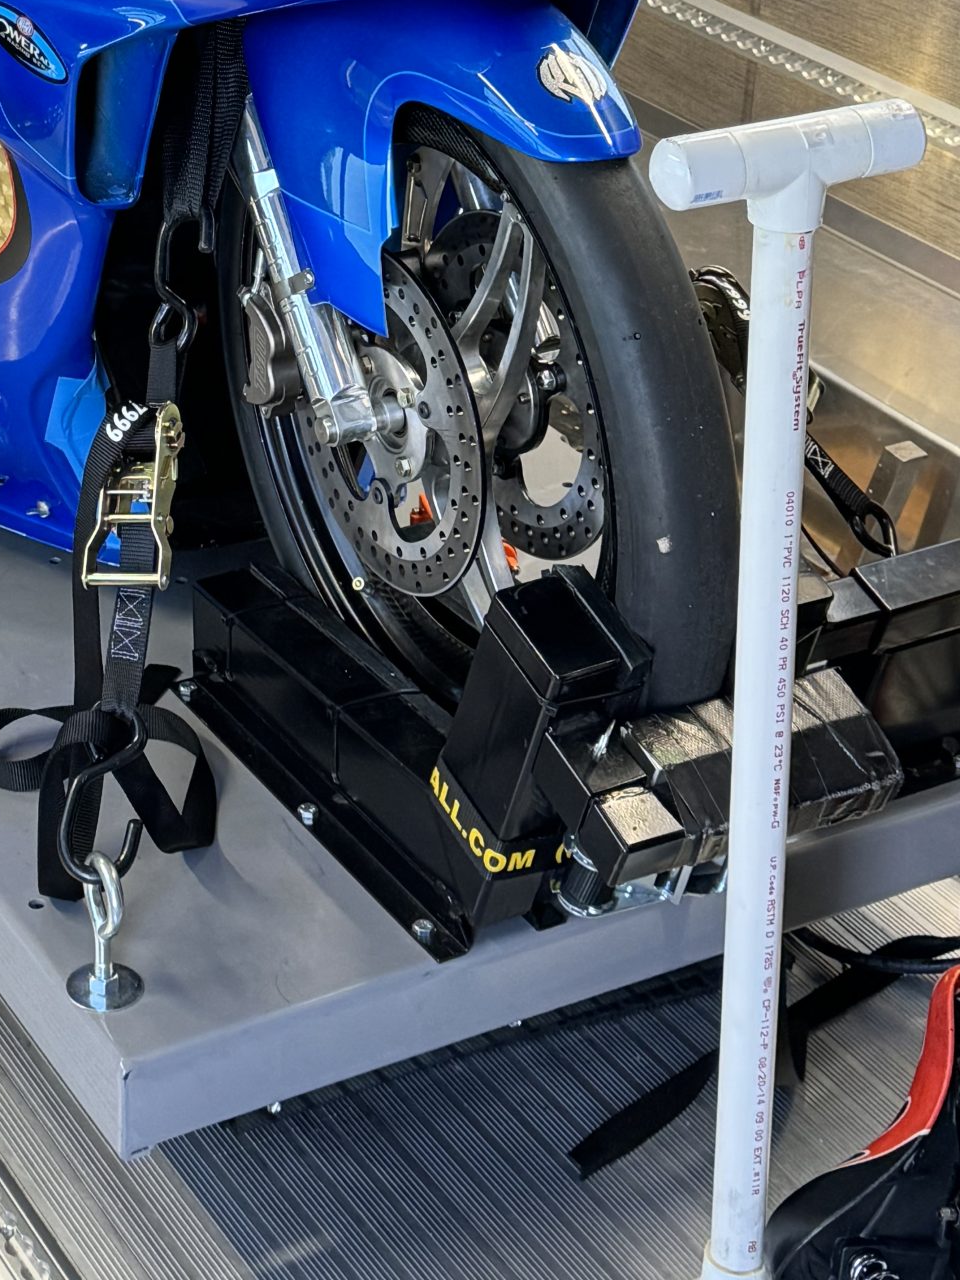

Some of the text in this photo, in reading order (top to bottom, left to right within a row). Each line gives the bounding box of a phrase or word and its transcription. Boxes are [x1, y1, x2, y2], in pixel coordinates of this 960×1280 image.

[785, 491, 795, 527] 04010
[781, 576, 792, 603] 1120
[780, 609, 790, 631] SCH
[779, 637, 789, 651] 40
[778, 657, 788, 671] PR
[777, 677, 787, 698] 450
[776, 704, 786, 724] PSI
[429, 766, 536, 873] ALL.COM
[766, 899, 776, 925] ASTM
[757, 1057, 767, 1105] 08/20/14
